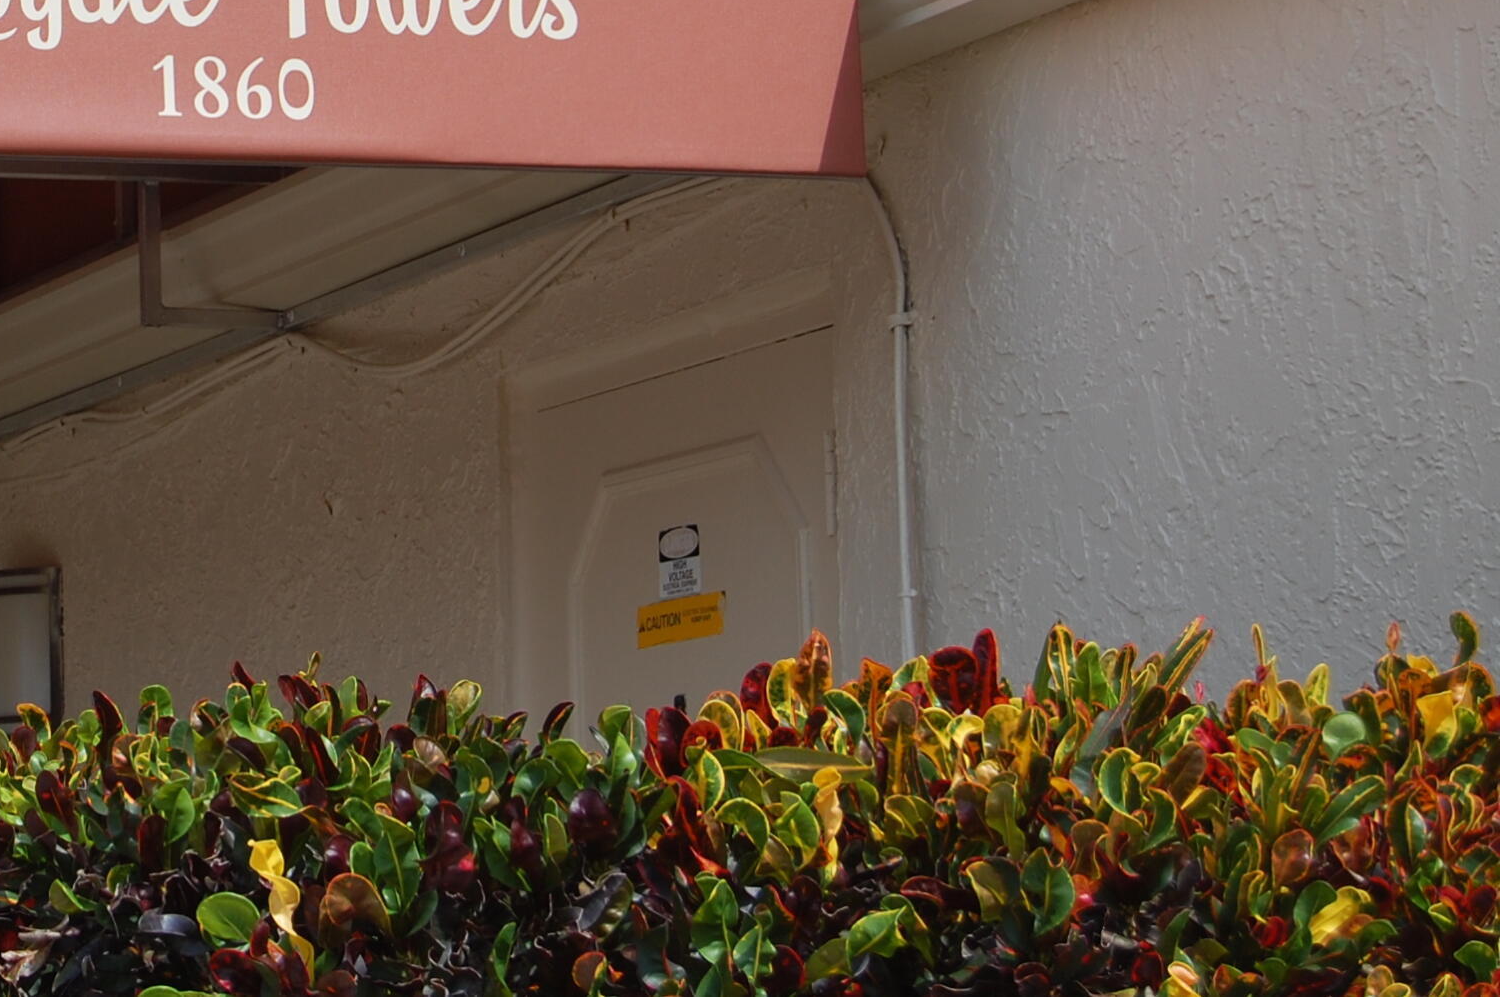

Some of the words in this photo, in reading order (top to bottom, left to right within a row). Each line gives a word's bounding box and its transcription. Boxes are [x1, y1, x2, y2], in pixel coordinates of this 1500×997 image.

[153, 55, 315, 120] 1860
[673, 560, 687, 569] HIGH
[668, 569, 693, 581] VOLTAGE
[646, 612, 681, 631] CAUTION
